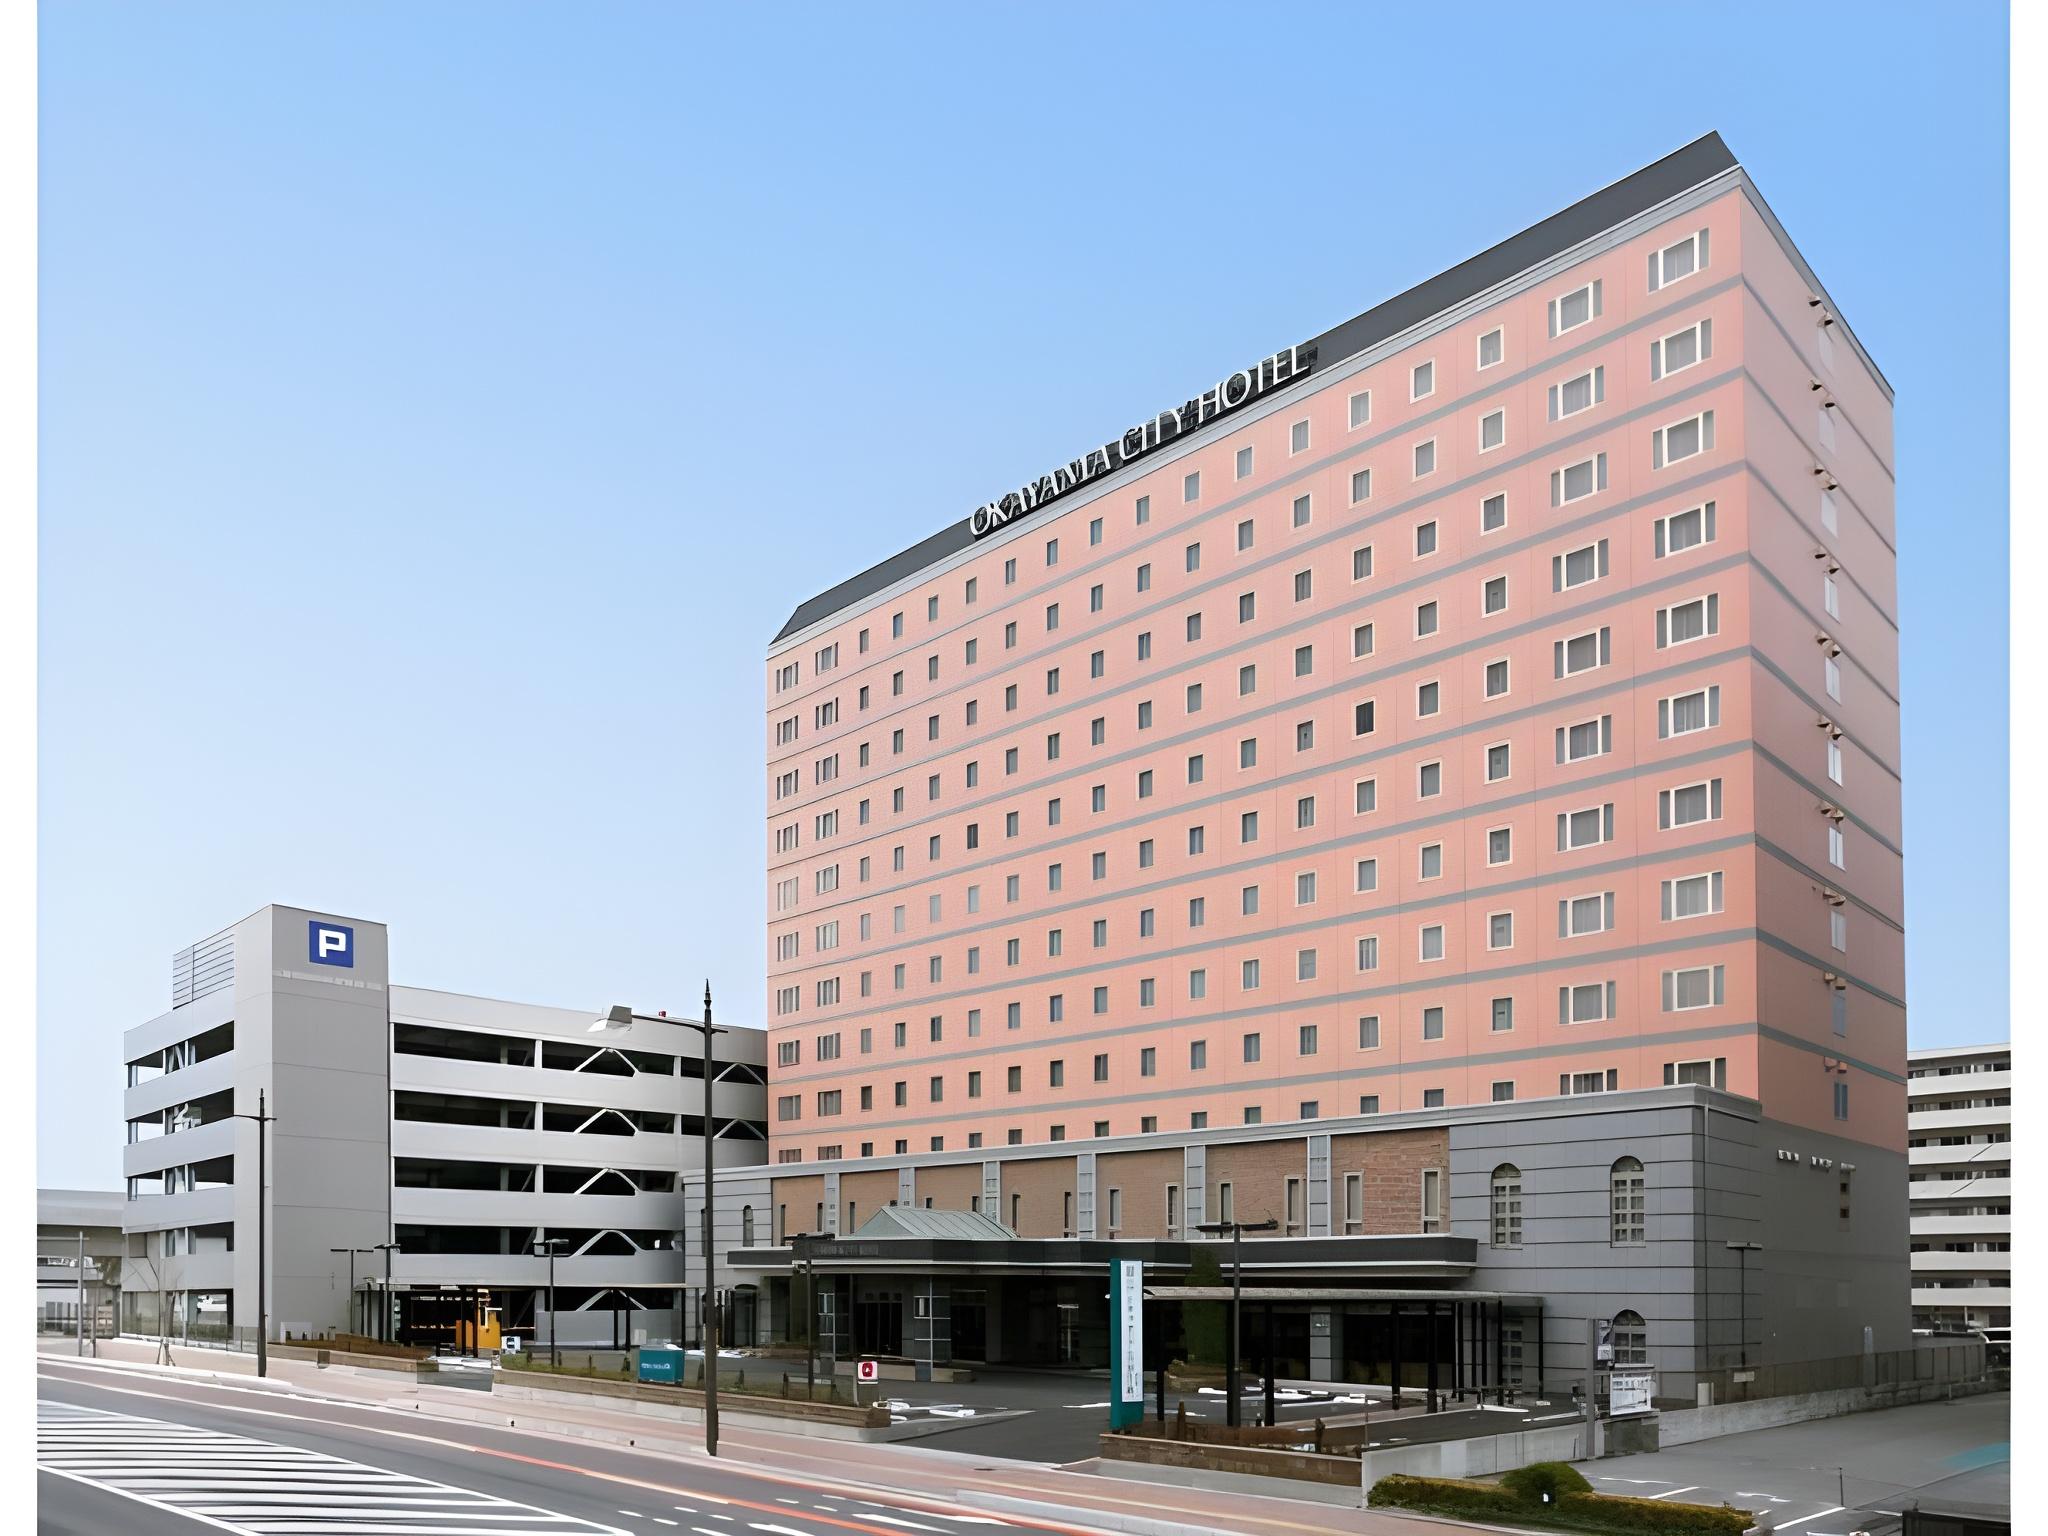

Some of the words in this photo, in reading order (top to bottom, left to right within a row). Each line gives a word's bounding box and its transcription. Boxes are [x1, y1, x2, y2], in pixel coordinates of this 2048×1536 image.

[1119, 402, 1191, 461] CITY
[1199, 345, 1311, 423] HOTEL
[319, 928, 346, 957] P
